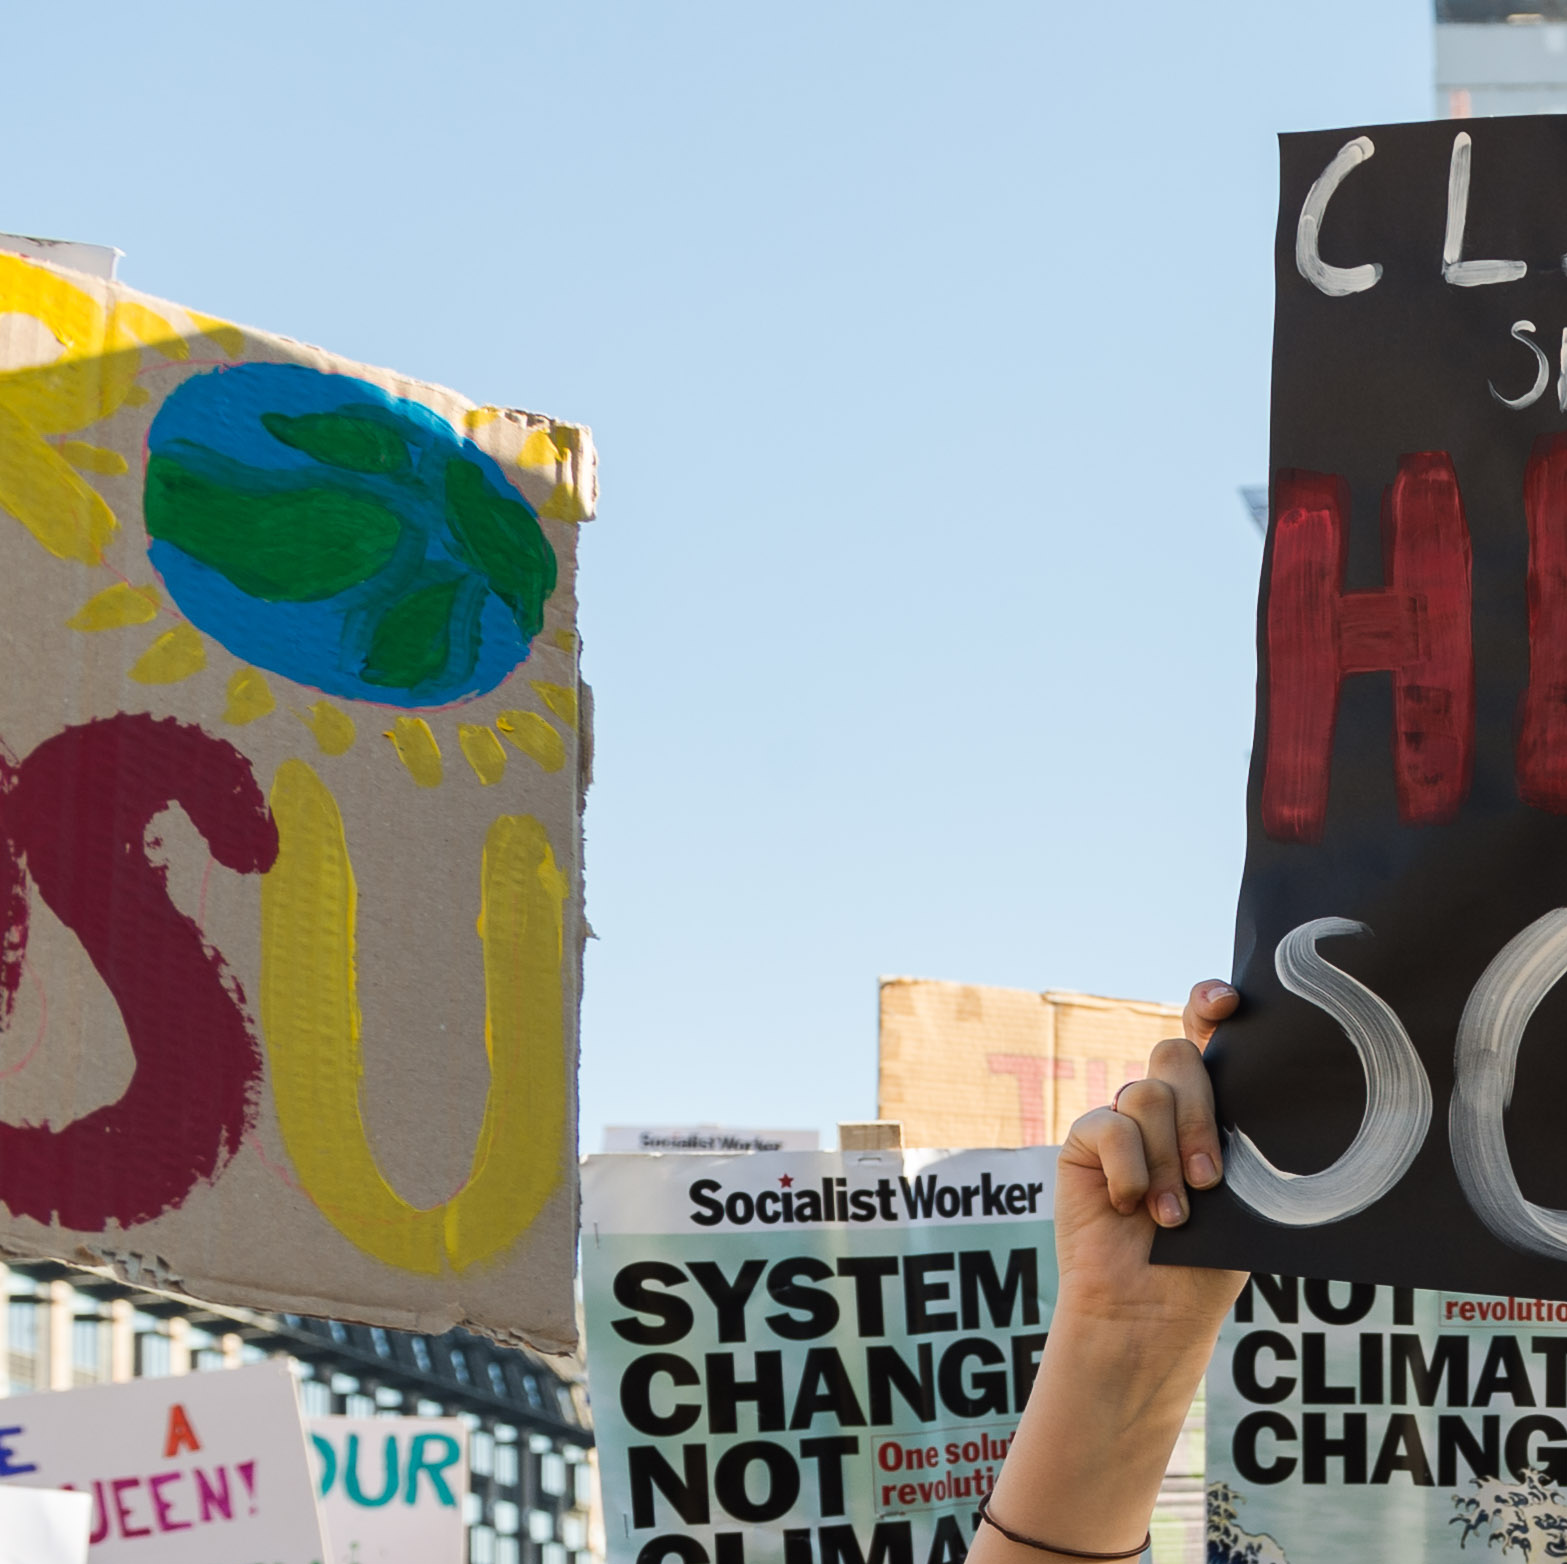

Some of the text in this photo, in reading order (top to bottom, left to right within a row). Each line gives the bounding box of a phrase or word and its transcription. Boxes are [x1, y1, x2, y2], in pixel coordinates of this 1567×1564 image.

[609, 1247, 1042, 1346] SYSTEM
[162, 1403, 203, 1458] A
[878, 1440, 938, 1472] One
[626, 1434, 860, 1529] NOT
